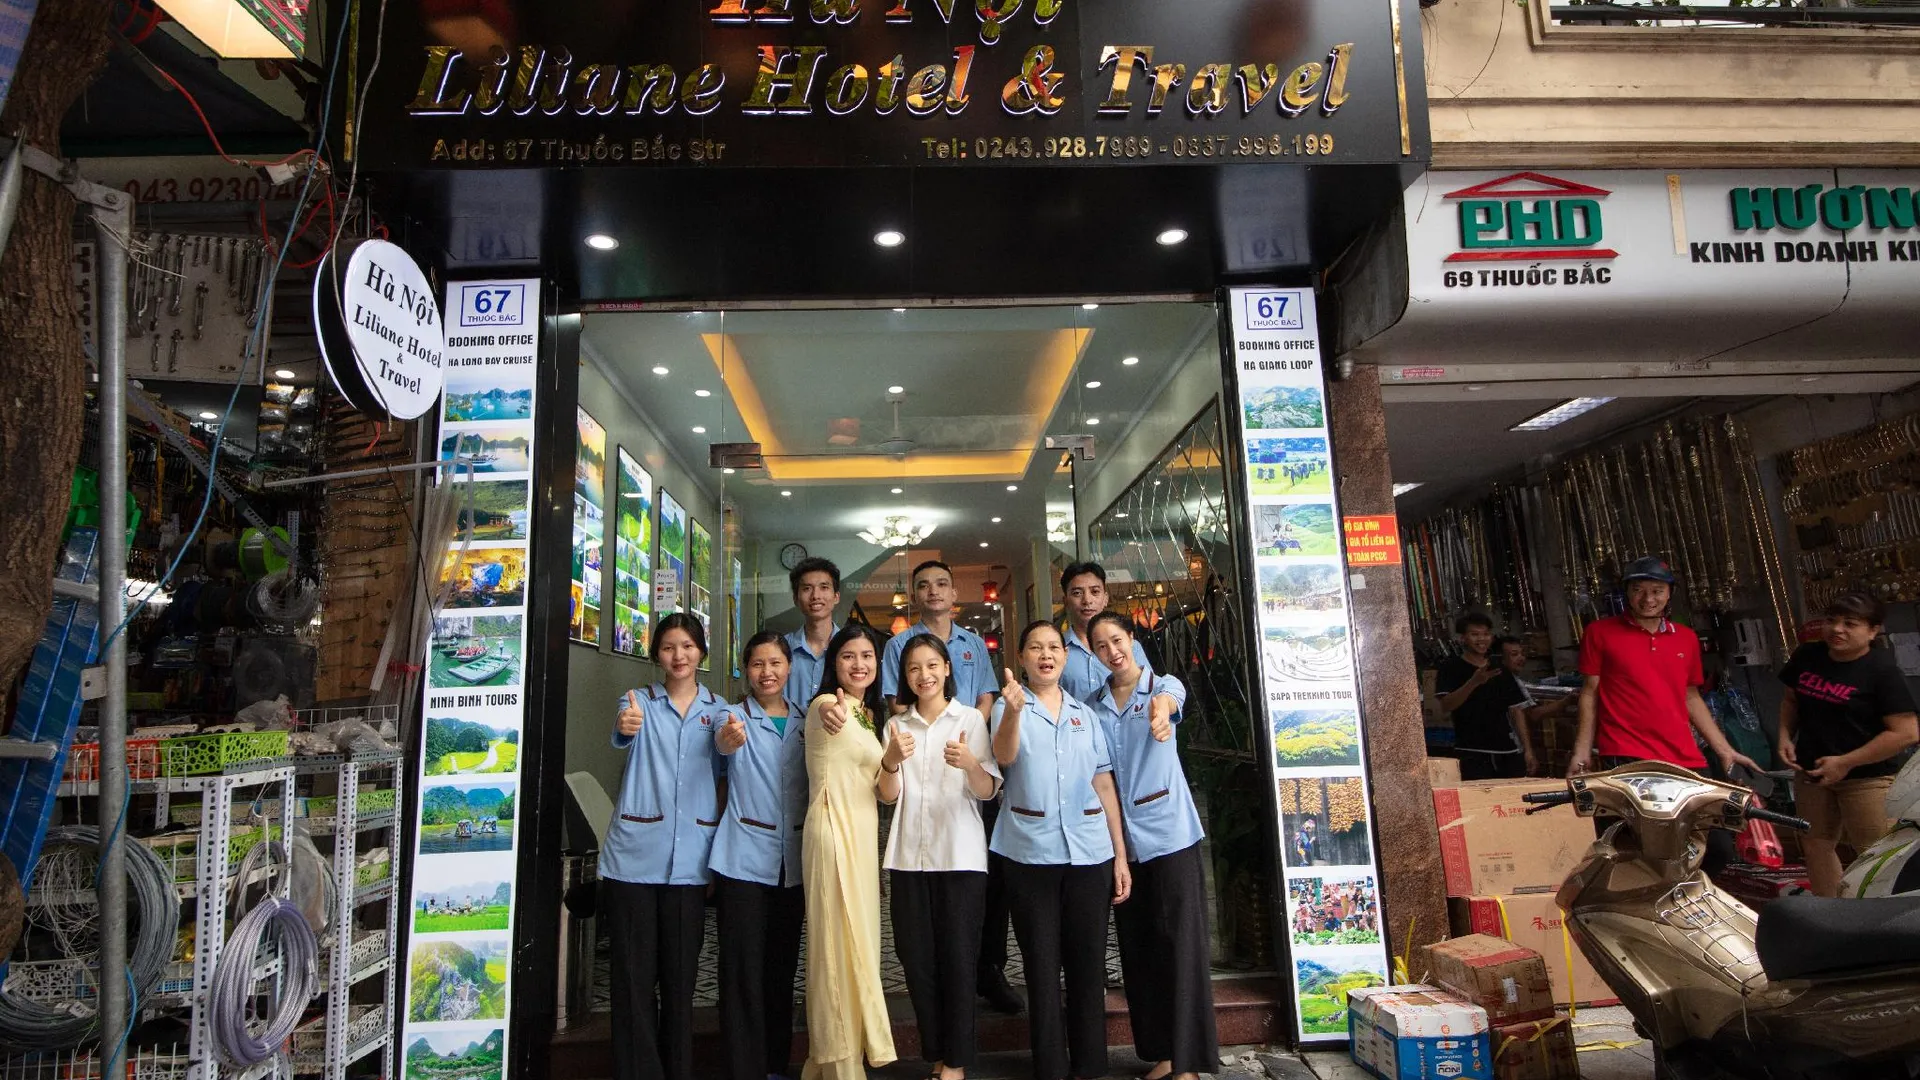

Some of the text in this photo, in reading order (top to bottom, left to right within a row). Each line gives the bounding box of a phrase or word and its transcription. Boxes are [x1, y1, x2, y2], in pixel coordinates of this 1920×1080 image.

[405, 42, 1354, 116] Liliane Hotel & Travel
[431, 132, 727, 162] Add: 67 Thuốc Bắc Str
[921, 138, 968, 160] Tel:
[1729, 183, 1920, 231] HƯƠN
[1459, 199, 1603, 248] PHD
[1690, 240, 1920, 263] KINH DOANH KI
[1444, 262, 1612, 288] 69 THUỐC BẮC
[364, 260, 434, 326] Hà Nội
[475, 290, 511, 314] 67
[1257, 297, 1289, 319] 67
[353, 303, 442, 368] Liliane Hotel
[448, 335, 534, 347] BOOKING OFFICE
[1239, 340, 1315, 350] BOOKING OFFICE
[396, 353, 404, 364] &
[448, 356, 533, 366] HA LONG BAY CRUISE
[1243, 360, 1313, 370] HA GIANG LOOP
[379, 359, 421, 394] Travel
[430, 693, 518, 709] NINH BINH TOURS
[1270, 690, 1352, 701] SAPA TREKKING TOUR
